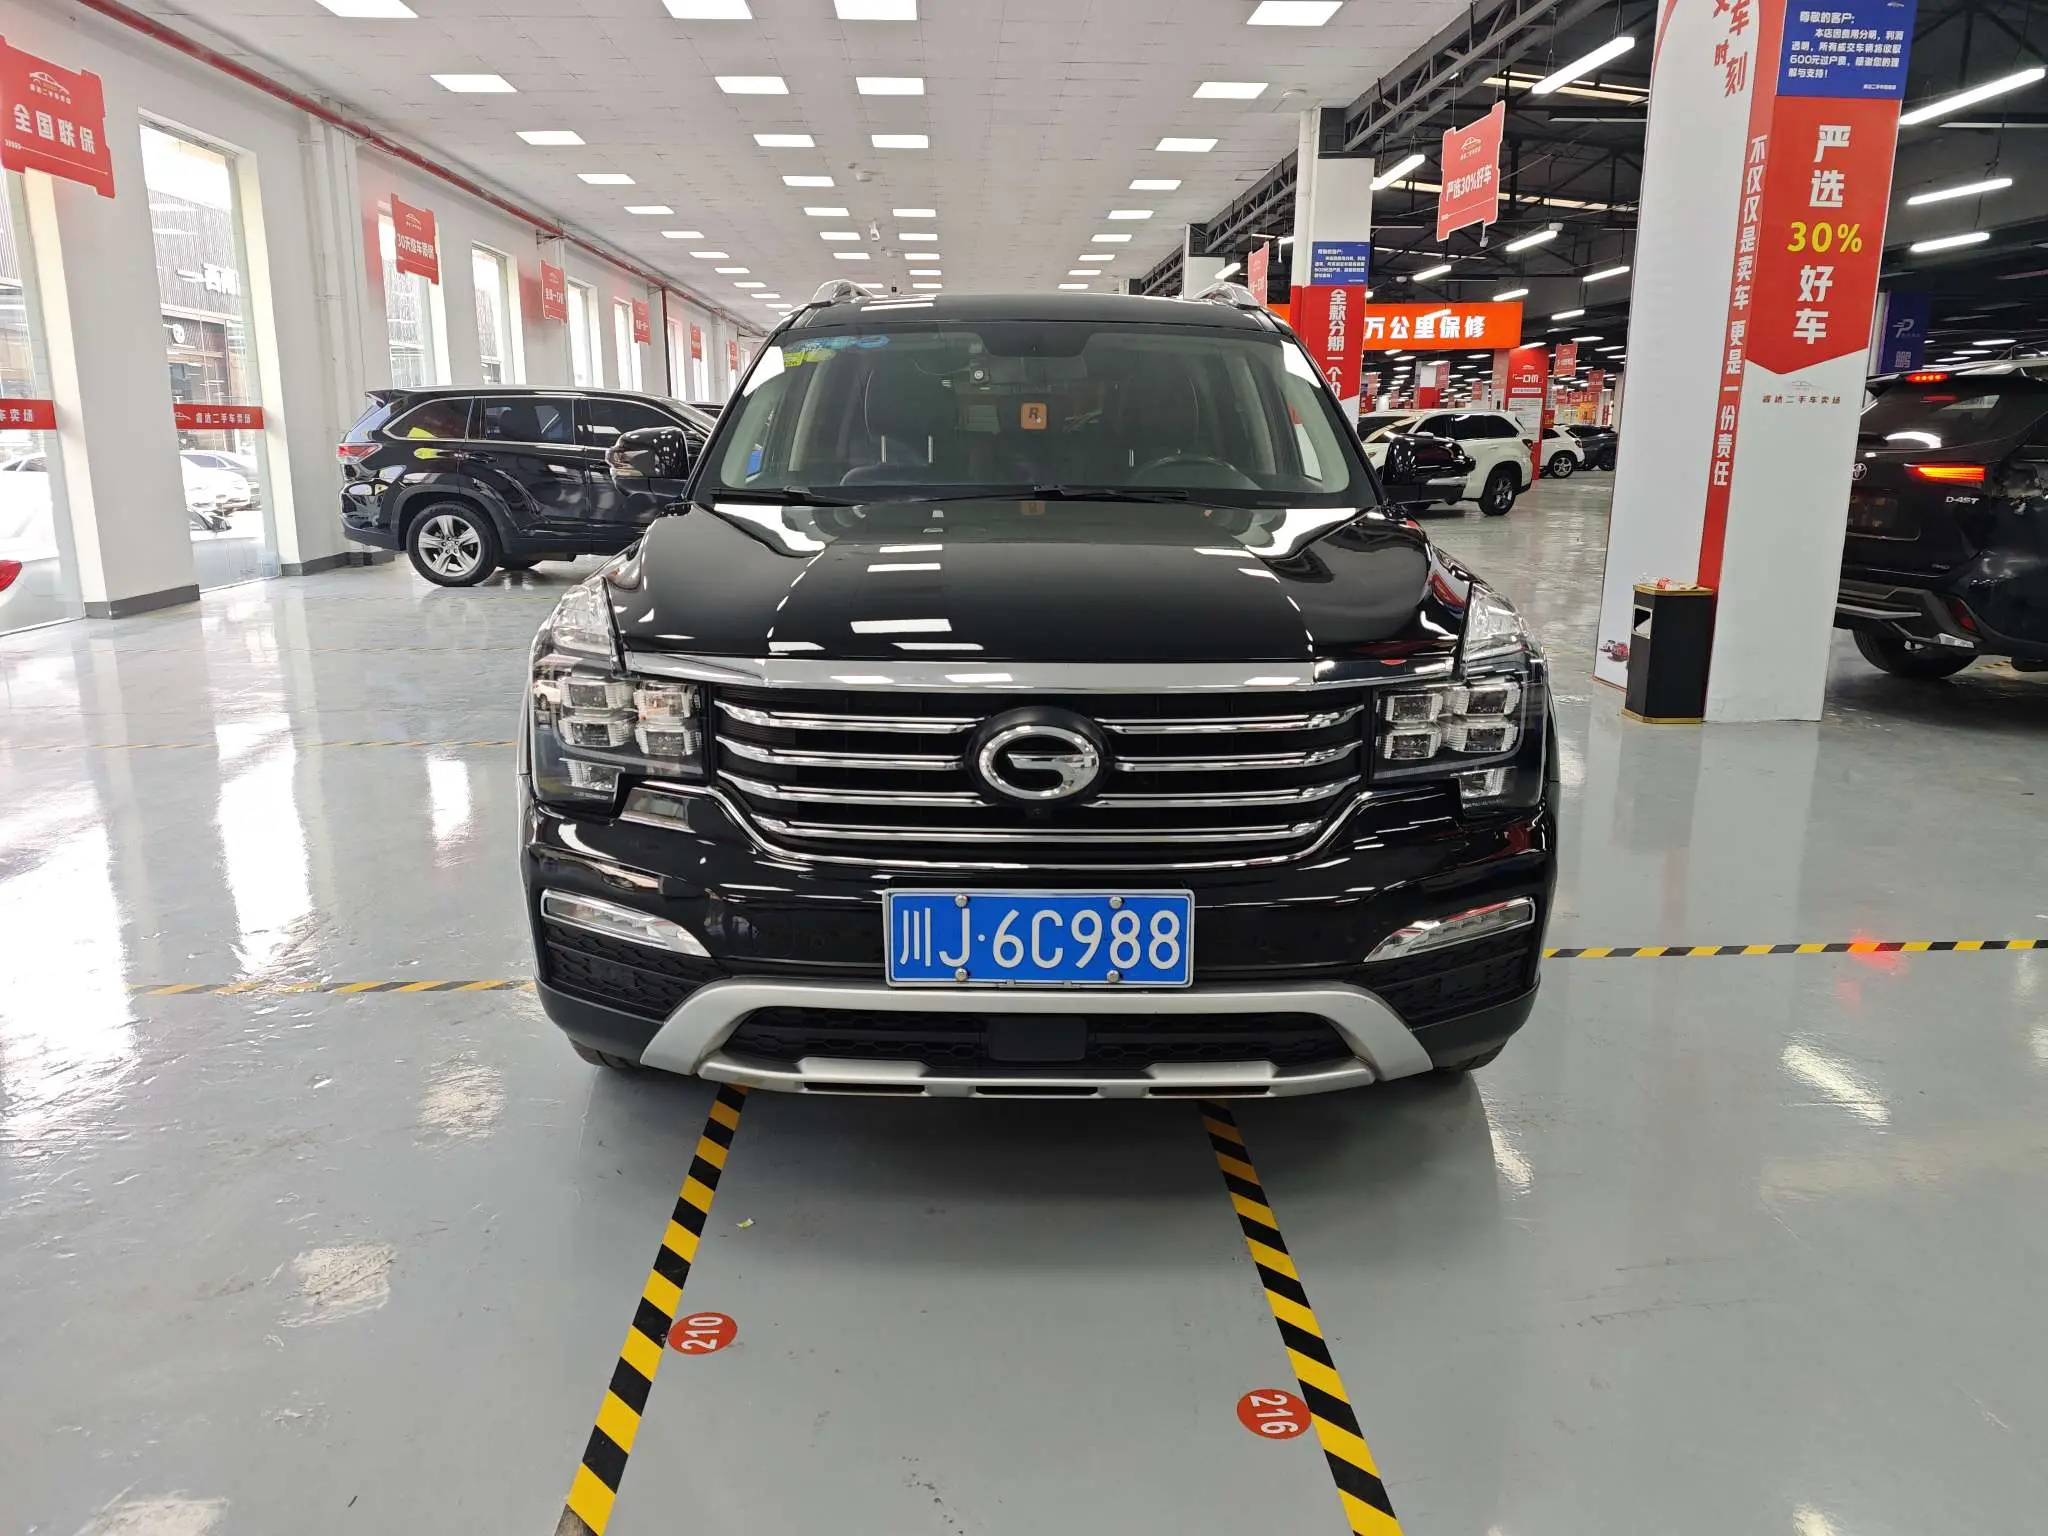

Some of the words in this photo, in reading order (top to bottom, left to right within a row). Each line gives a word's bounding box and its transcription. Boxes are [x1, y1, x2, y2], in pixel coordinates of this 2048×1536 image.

[14, 103, 96, 154] 全国联保
[1446, 164, 1493, 202] 严选30%好车
[1364, 315, 1486, 340] 万公里保修
[899, 907, 1181, 969] 川J·6C988
[681, 1316, 723, 1350] 210
[1249, 1394, 1299, 1434] 216
